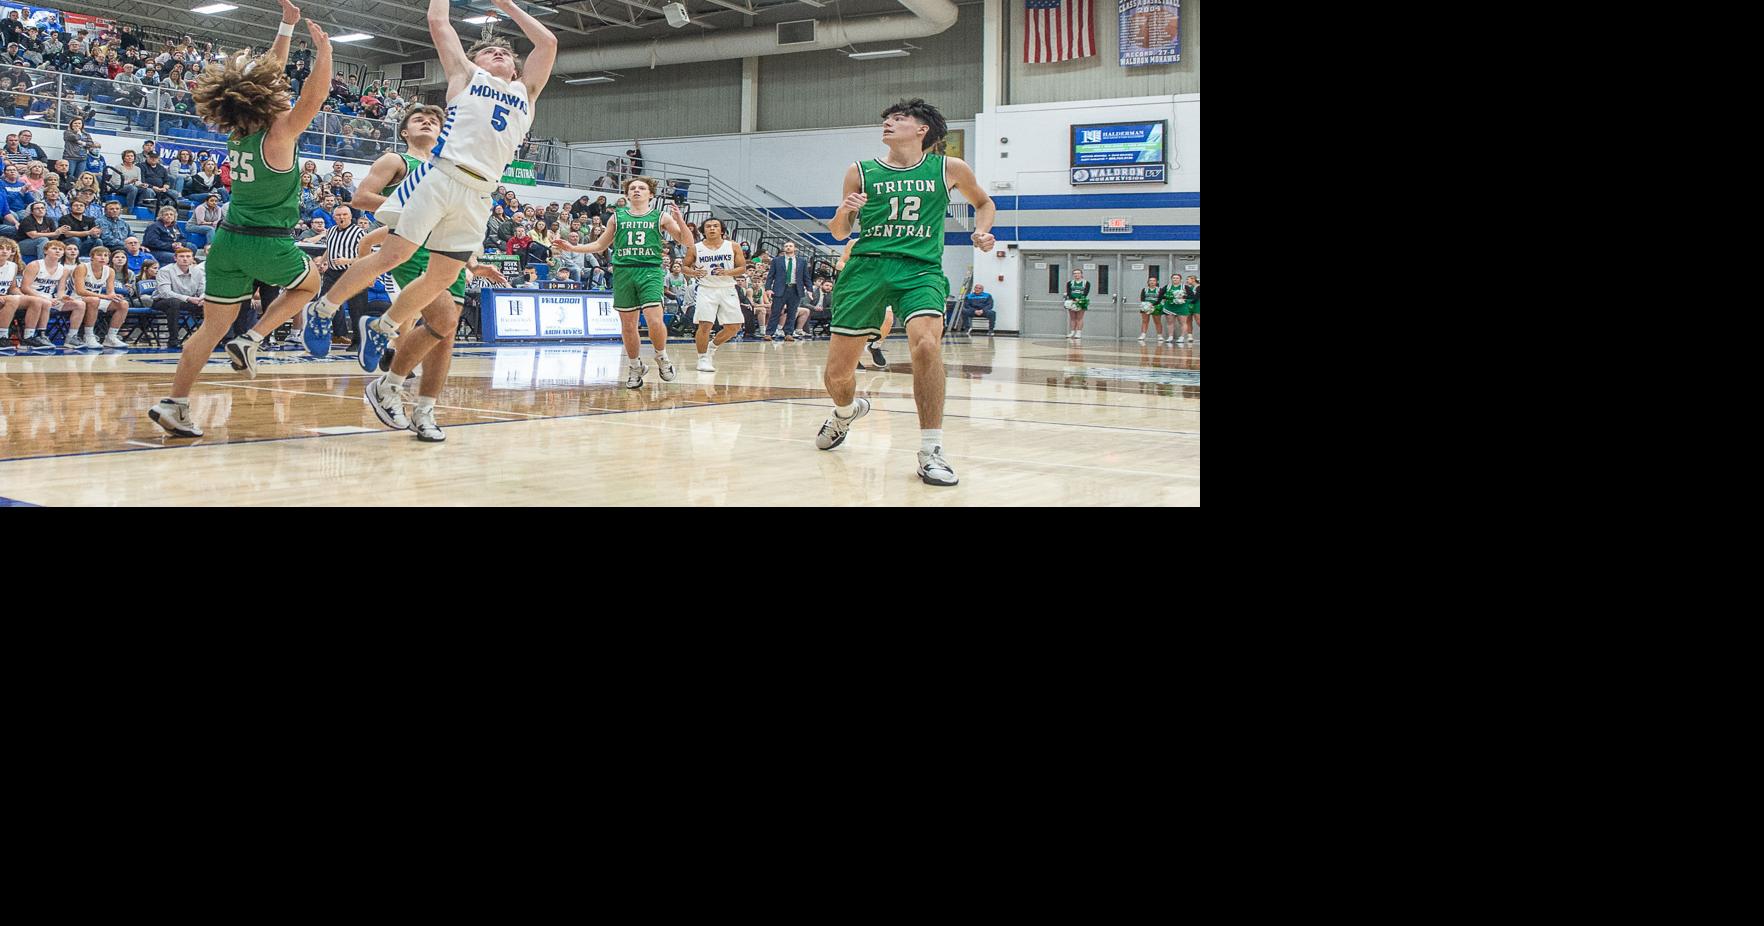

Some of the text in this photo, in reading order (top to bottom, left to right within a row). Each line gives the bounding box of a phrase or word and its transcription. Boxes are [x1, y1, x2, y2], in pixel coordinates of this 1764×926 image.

[1120, 54, 1180, 65] WALDRON MOHAWKS
[491, 104, 510, 132] 5
[230, 150, 255, 182] 25
[1089, 168, 1144, 177] WALDRON
[873, 180, 935, 195] TRITON
[888, 196, 921, 221] 12
[620, 221, 655, 229] TRITON
[627, 231, 646, 246] 13
[618, 248, 656, 257] CENTRAL
[699, 254, 732, 263] MOHAWKS
